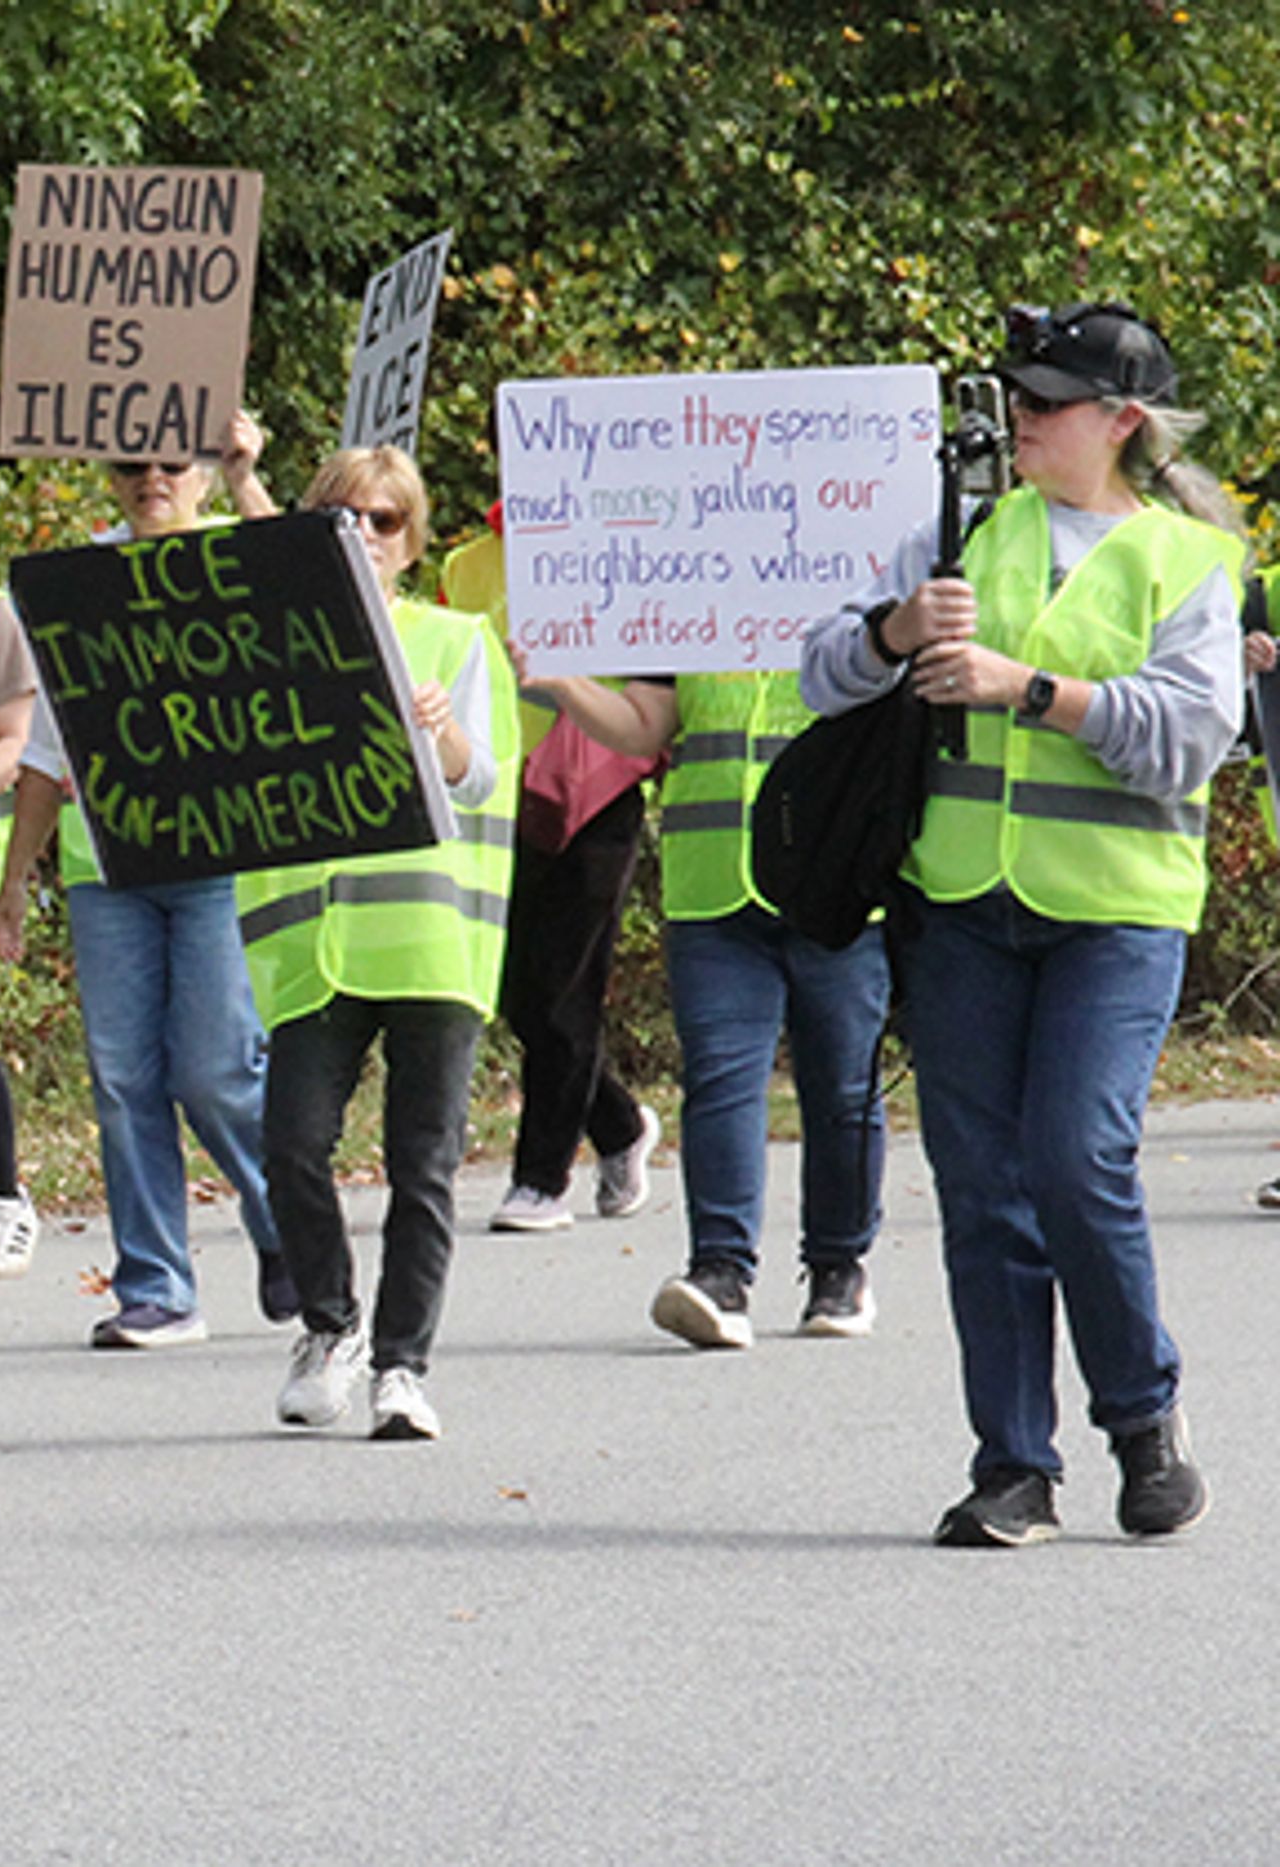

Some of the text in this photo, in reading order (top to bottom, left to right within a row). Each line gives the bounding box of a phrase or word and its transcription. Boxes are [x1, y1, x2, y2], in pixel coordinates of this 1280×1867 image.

[38, 173, 238, 236] NINGUN
[17, 242, 239, 308] HUMANO
[365, 243, 439, 348] END
[87, 317, 144, 369] ES
[12, 382, 227, 460] ILEGAL
[351, 340, 423, 446] ICE
[506, 396, 600, 482] Why
[609, 418, 673, 450] are
[683, 395, 761, 467] they
[765, 402, 900, 464] spending
[506, 463, 884, 540] much money jailing our
[118, 527, 251, 611] ICE
[752, 540, 854, 582] when
[32, 606, 372, 700] IMMORAL
[618, 599, 717, 645] afford
[734, 615, 809, 664] groc
[117, 687, 336, 765] CRUEL
[85, 691, 417, 858] UN-AMERICAN
